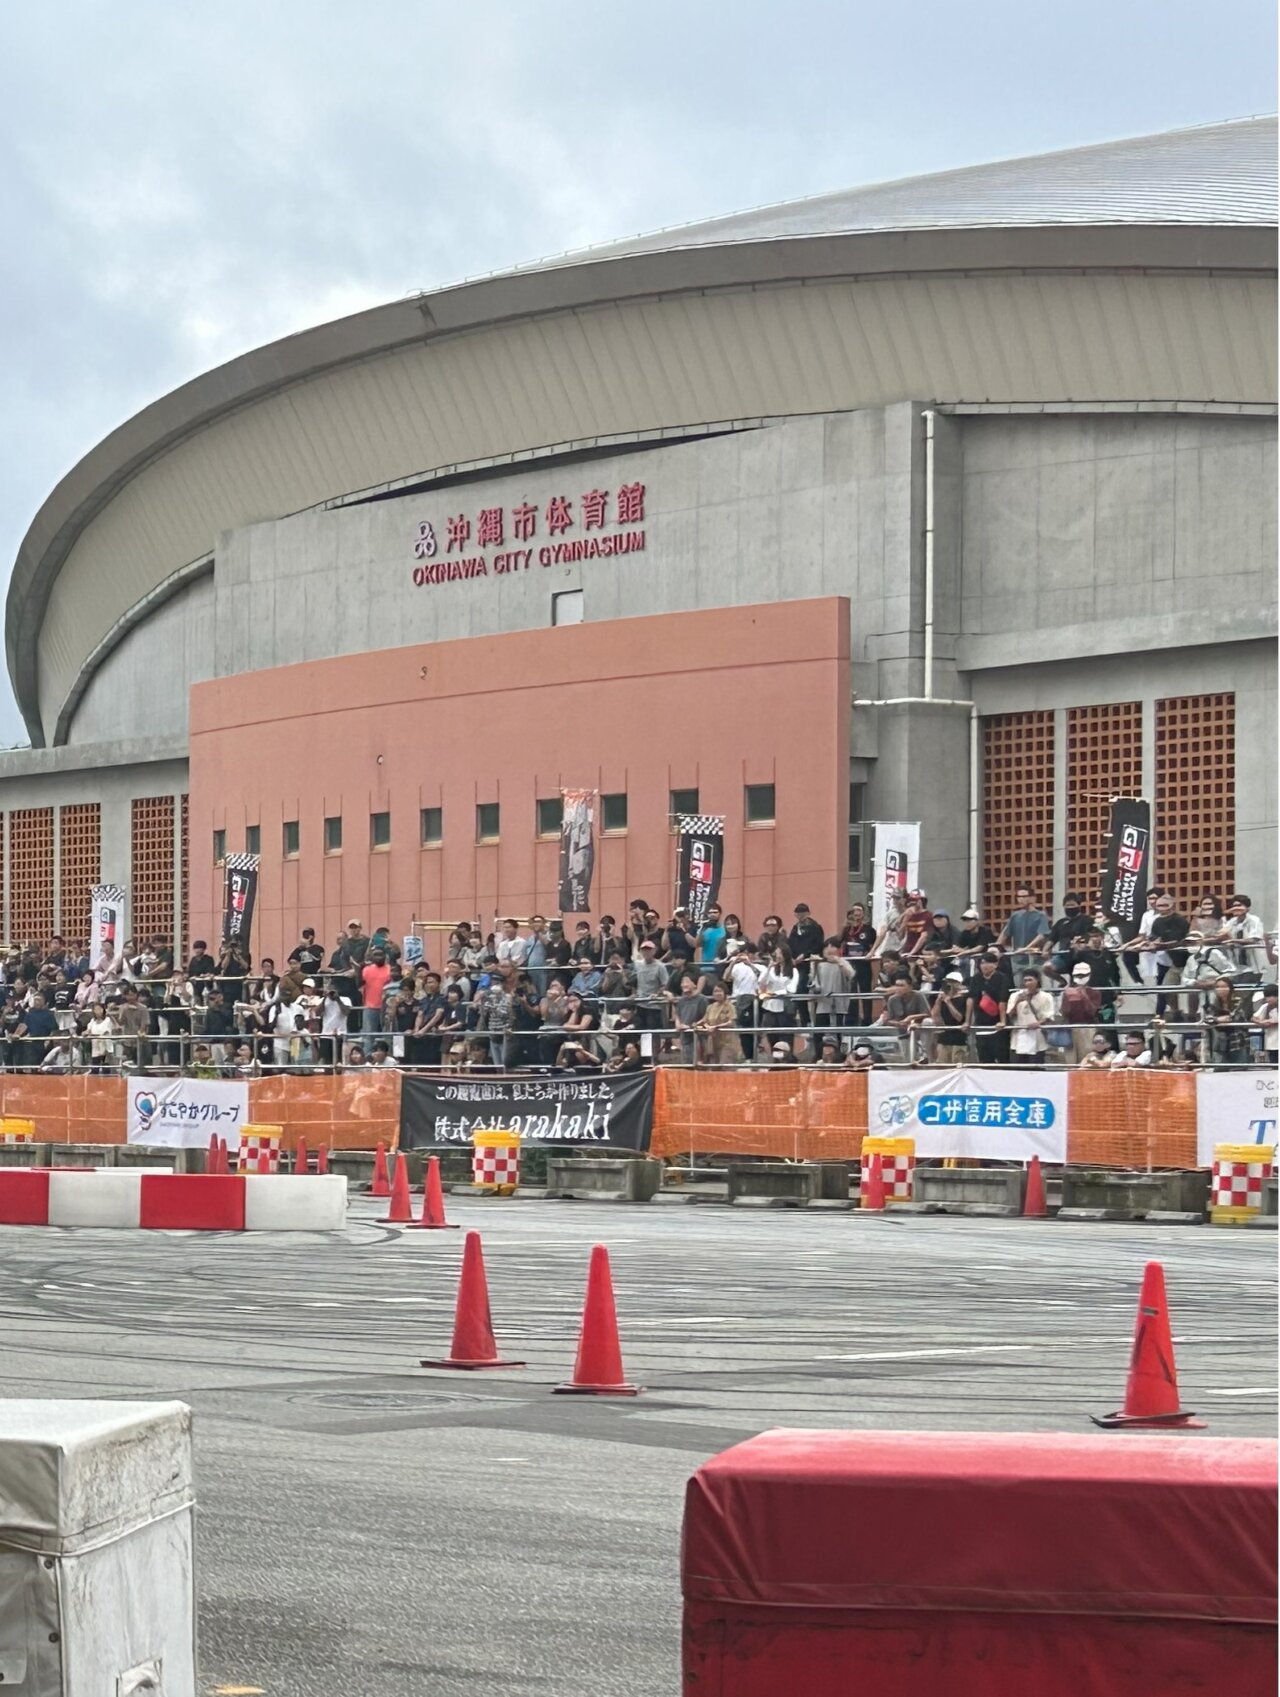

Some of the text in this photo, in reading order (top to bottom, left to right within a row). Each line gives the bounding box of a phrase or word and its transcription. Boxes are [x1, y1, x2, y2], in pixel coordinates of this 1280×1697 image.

[445, 482, 646, 553] 沖縄市体育館
[412, 530, 646, 586] OKINAWA CITY GYMNASIUM
[160, 1101, 240, 1123] すこやかグループ
[923, 1098, 1048, 1126] コザ信用金庫
